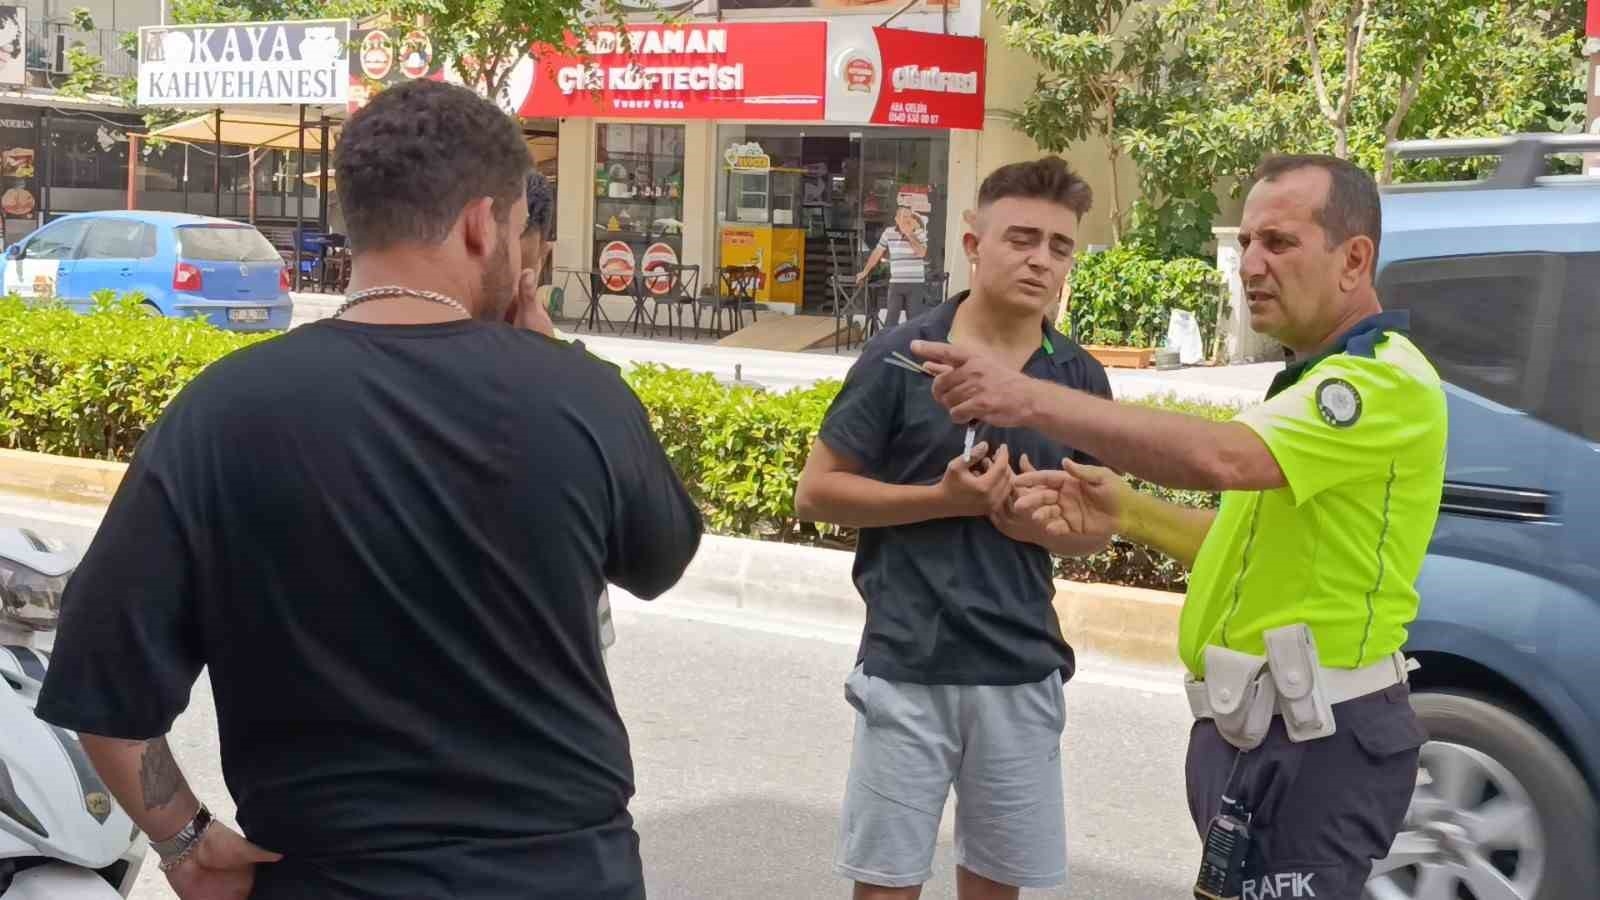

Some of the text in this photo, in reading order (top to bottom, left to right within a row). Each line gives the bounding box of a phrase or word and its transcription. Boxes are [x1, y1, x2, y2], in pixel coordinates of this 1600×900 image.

[191, 25, 293, 64] KAYA
[149, 62, 337, 98] KAHVEHANESİ
[1242, 872, 1316, 900] RAFİK
